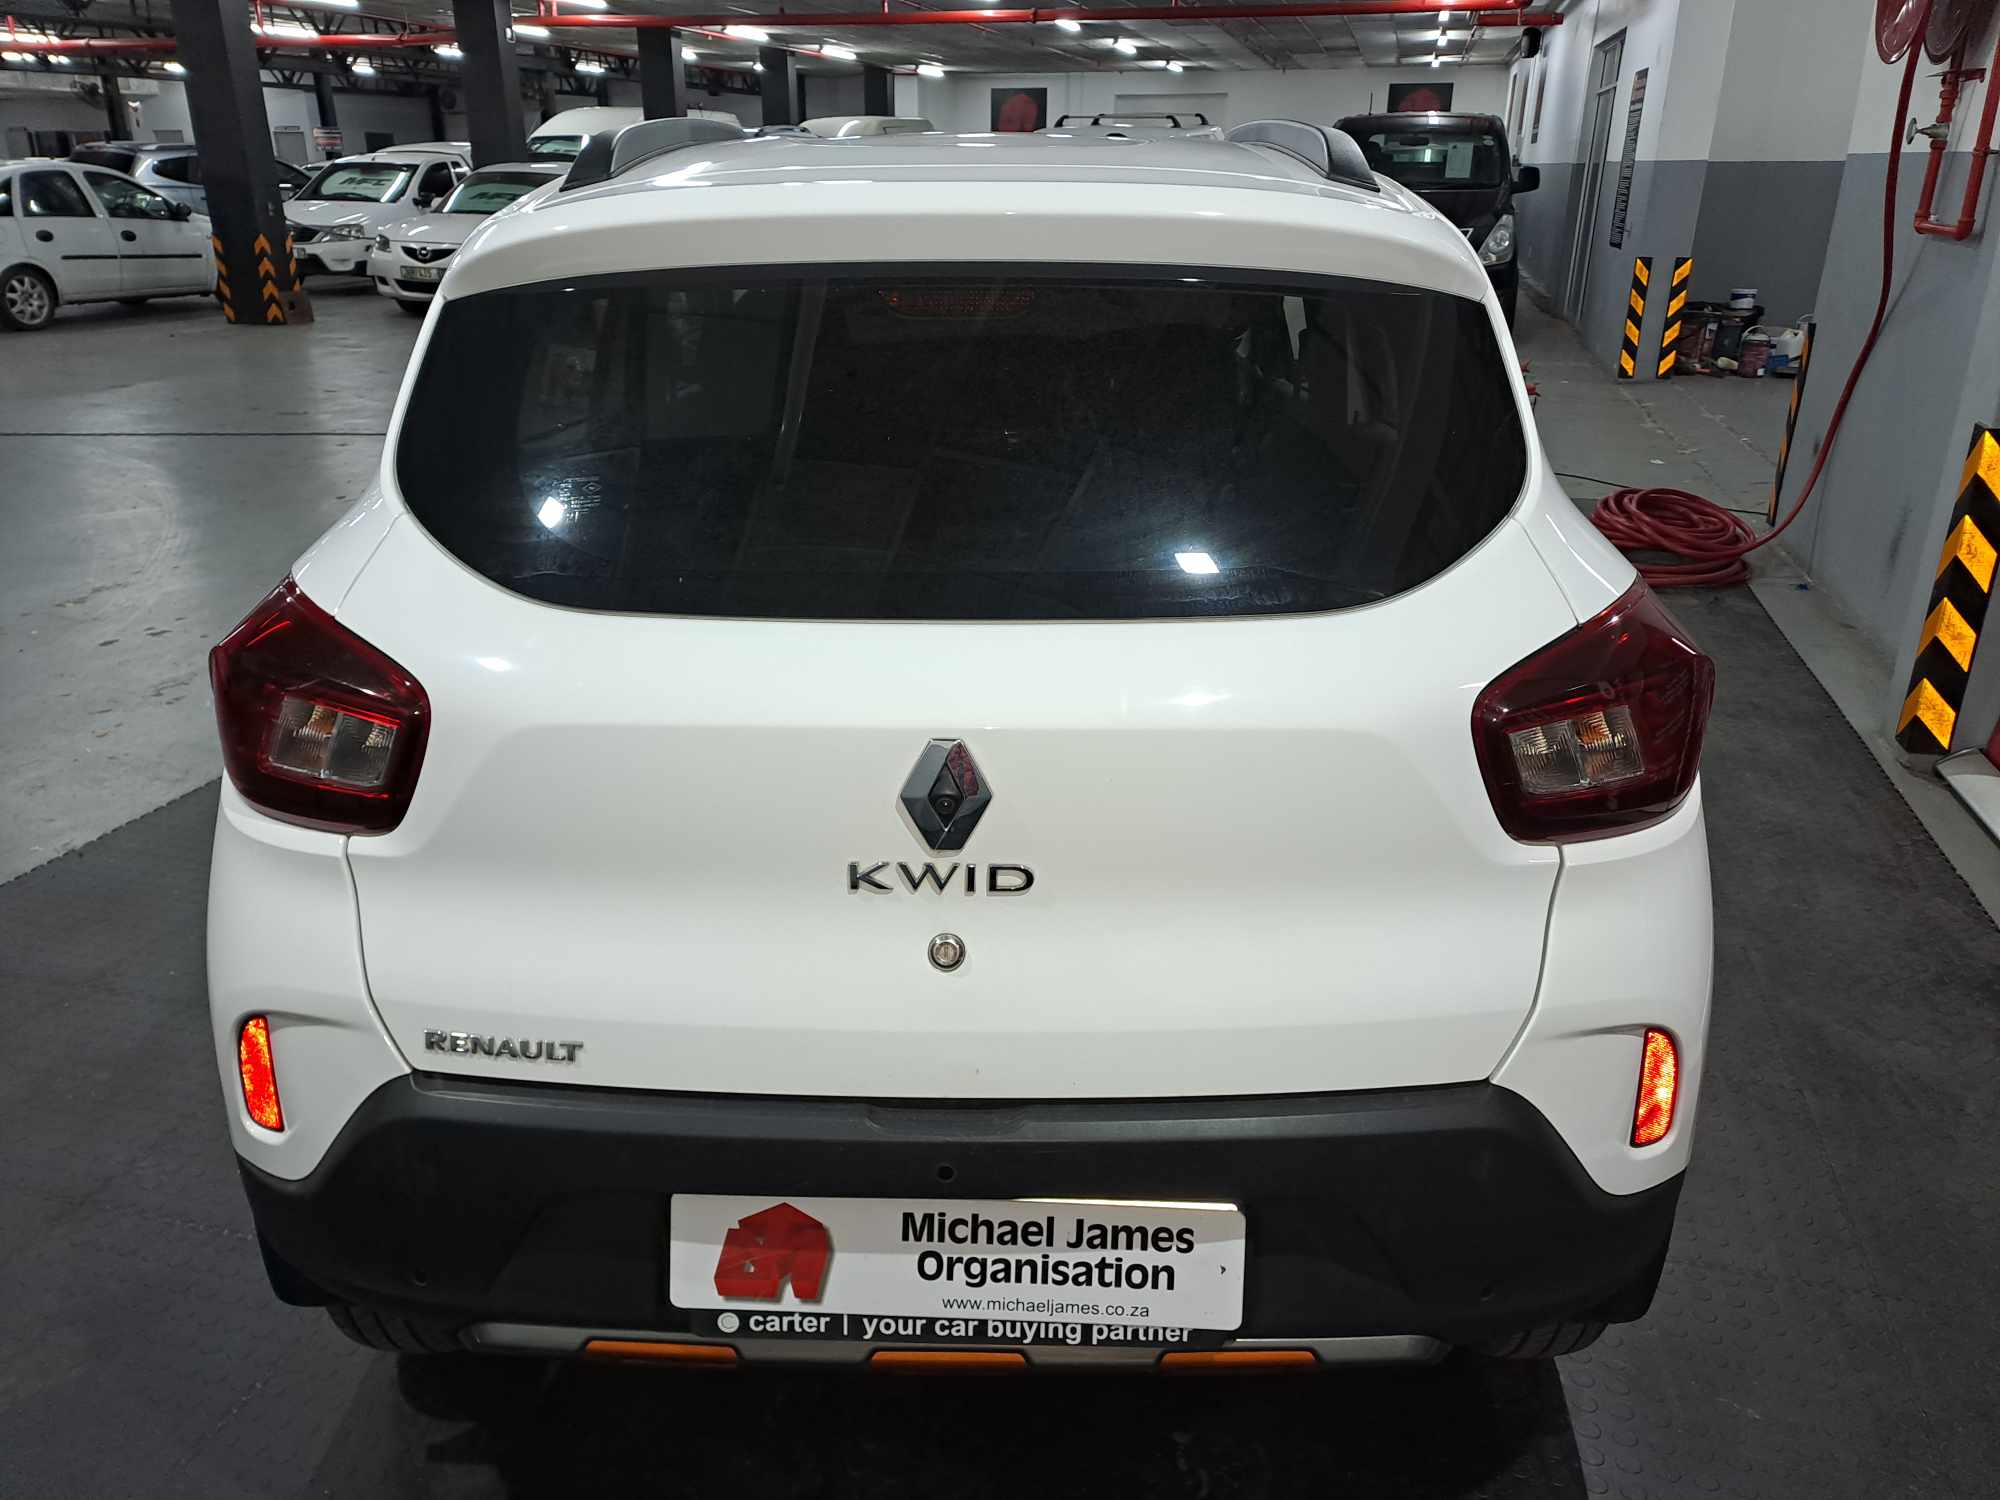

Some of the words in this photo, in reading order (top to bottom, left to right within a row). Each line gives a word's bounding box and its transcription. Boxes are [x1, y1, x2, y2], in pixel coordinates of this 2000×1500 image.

[848, 861, 1035, 896] KWID
[424, 1029, 583, 1062] RENAULT
[901, 1212, 1055, 1248] Michael
[1066, 1218, 1196, 1253] James
[916, 1249, 1176, 1291] Organisation
[942, 1297, 1150, 1318] www.michaeljames.co.za
[750, 1313, 831, 1333] carter
[863, 1317, 927, 1340] your
[934, 1319, 978, 1337] car
[986, 1320, 1083, 1345] buying
